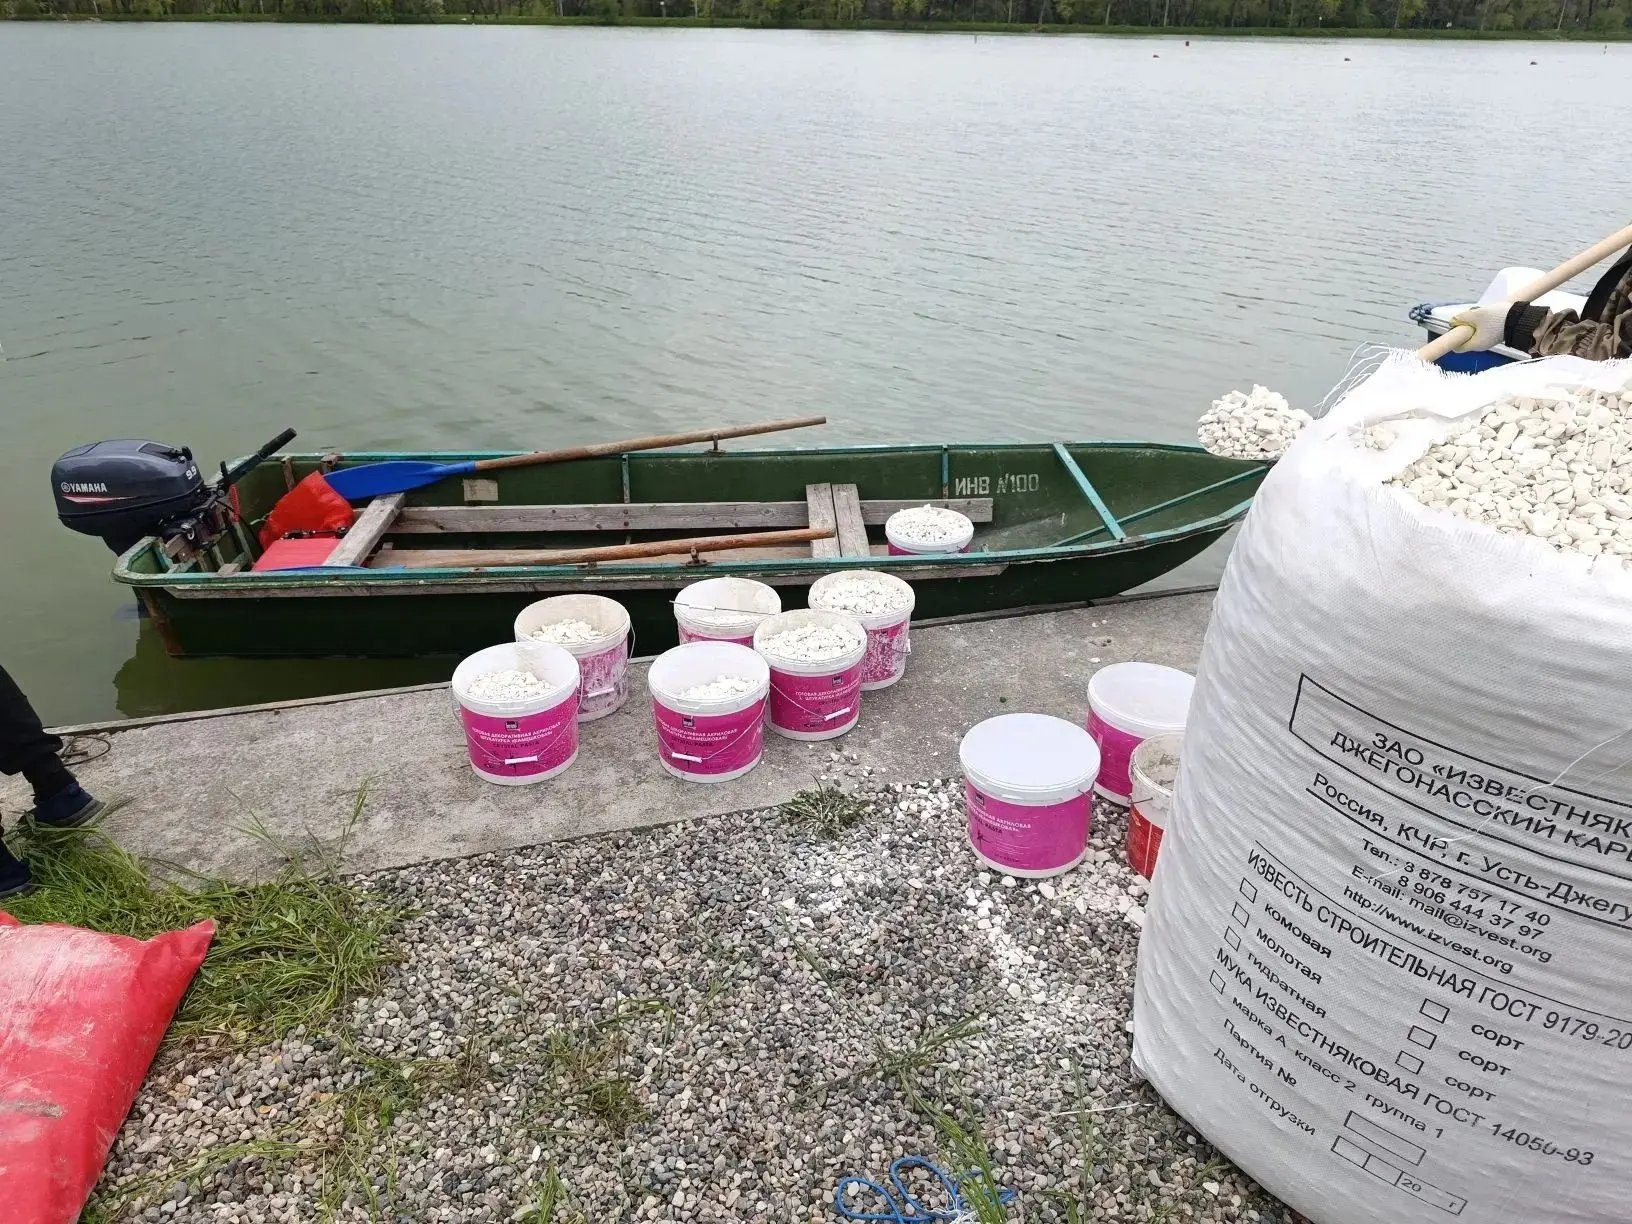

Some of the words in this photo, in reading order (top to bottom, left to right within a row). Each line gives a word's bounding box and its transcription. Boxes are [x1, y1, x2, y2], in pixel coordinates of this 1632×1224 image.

[70, 483, 108, 493] YAMAHA
[955, 476, 991, 496] ИНВ
[1372, 732, 1425, 767] ЗАО
[1330, 730, 1557, 839] ДЖЕГОНАССКИЙ
[1362, 838, 1400, 867] Тел.:
[1418, 868, 1453, 889] 878
[1457, 883, 1493, 903] 757
[1500, 900, 1522, 915] 17
[1525, 911, 1551, 926] 40
[1398, 875, 1409, 887] 8
[1413, 882, 1446, 904] 906
[1450, 899, 1485, 919] 444
[1489, 911, 1514, 930] 37
[1518, 924, 1545, 940] 97
[1247, 848, 1313, 914] ИЗВЕСТЬ
[1317, 904, 1477, 999] СТРОИТЕЛЬНАЯ
[1479, 985, 1542, 1023] ГОСТ
[1255, 927, 1323, 985] молотая
[1264, 903, 1333, 960] комовая
[1343, 885, 1514, 975] http://www.izvest.org
[1409, 897, 1553, 964] mail@izvest.org
[1246, 950, 1328, 1020] гидратная
[1216, 947, 1254, 993] МУКА
[1255, 987, 1420, 1101] ИЗВЕСТНЯКОВАЯ
[1423, 1092, 1486, 1129] ГОСТ
[1223, 1018, 1274, 1070] Партия
[1277, 1066, 1299, 1087] №
[1231, 996, 1274, 1038] марка
[1275, 1034, 1288, 1049] А
[1294, 1048, 1341, 1084] класс
[1343, 1079, 1357, 1094] 2
[1365, 1092, 1426, 1132] группа
[1434, 1126, 1445, 1140] 1
[1457, 1048, 1512, 1077] сорт
[1471, 1023, 1526, 1052] сорт
[1213, 1047, 1247, 1085] Дата
[1249, 1082, 1317, 1137] отгрузки
[1444, 1074, 1497, 1102] сорт
[1401, 1178, 1422, 1193] 20
